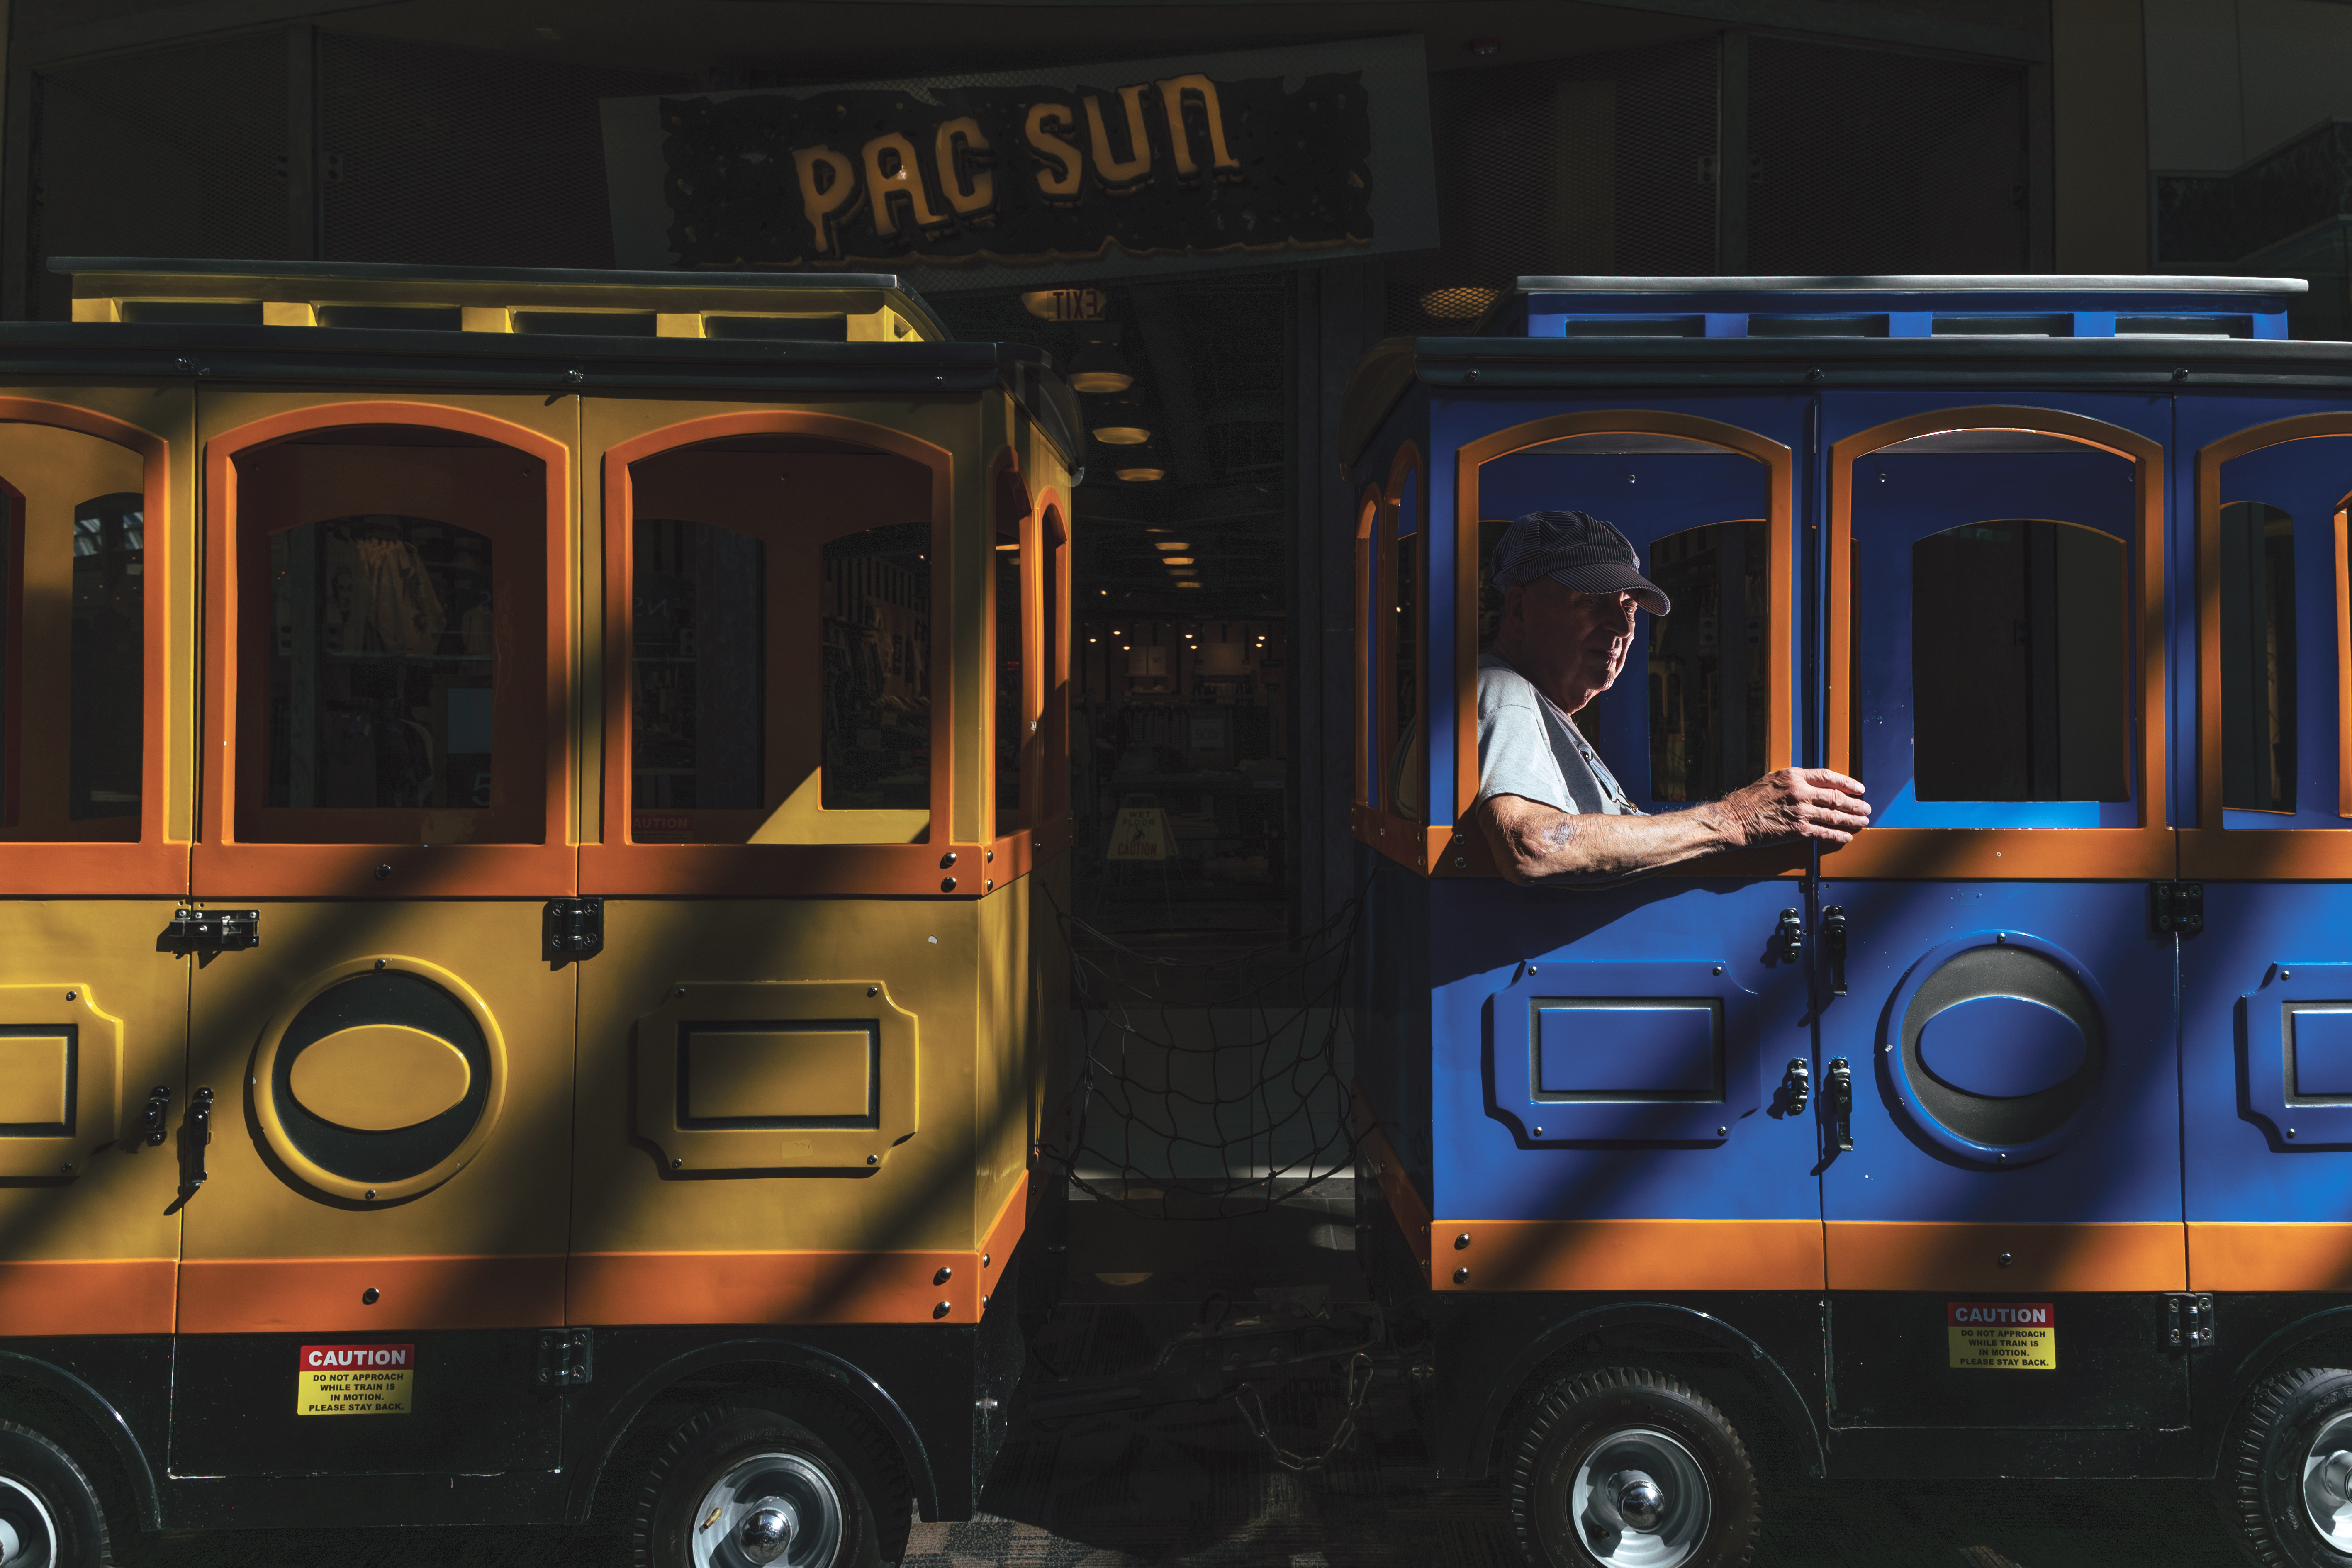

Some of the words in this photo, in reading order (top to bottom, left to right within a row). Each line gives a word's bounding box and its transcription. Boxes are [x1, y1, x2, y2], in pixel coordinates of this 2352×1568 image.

[792, 116, 996, 260] PAC
[1024, 72, 1240, 205] SUN
[632, 818, 687, 828] AUTION
[1118, 843, 1157, 855] CAUTION
[1955, 1307, 2045, 1323] CAUTION
[309, 1350, 405, 1366] CAUTION
